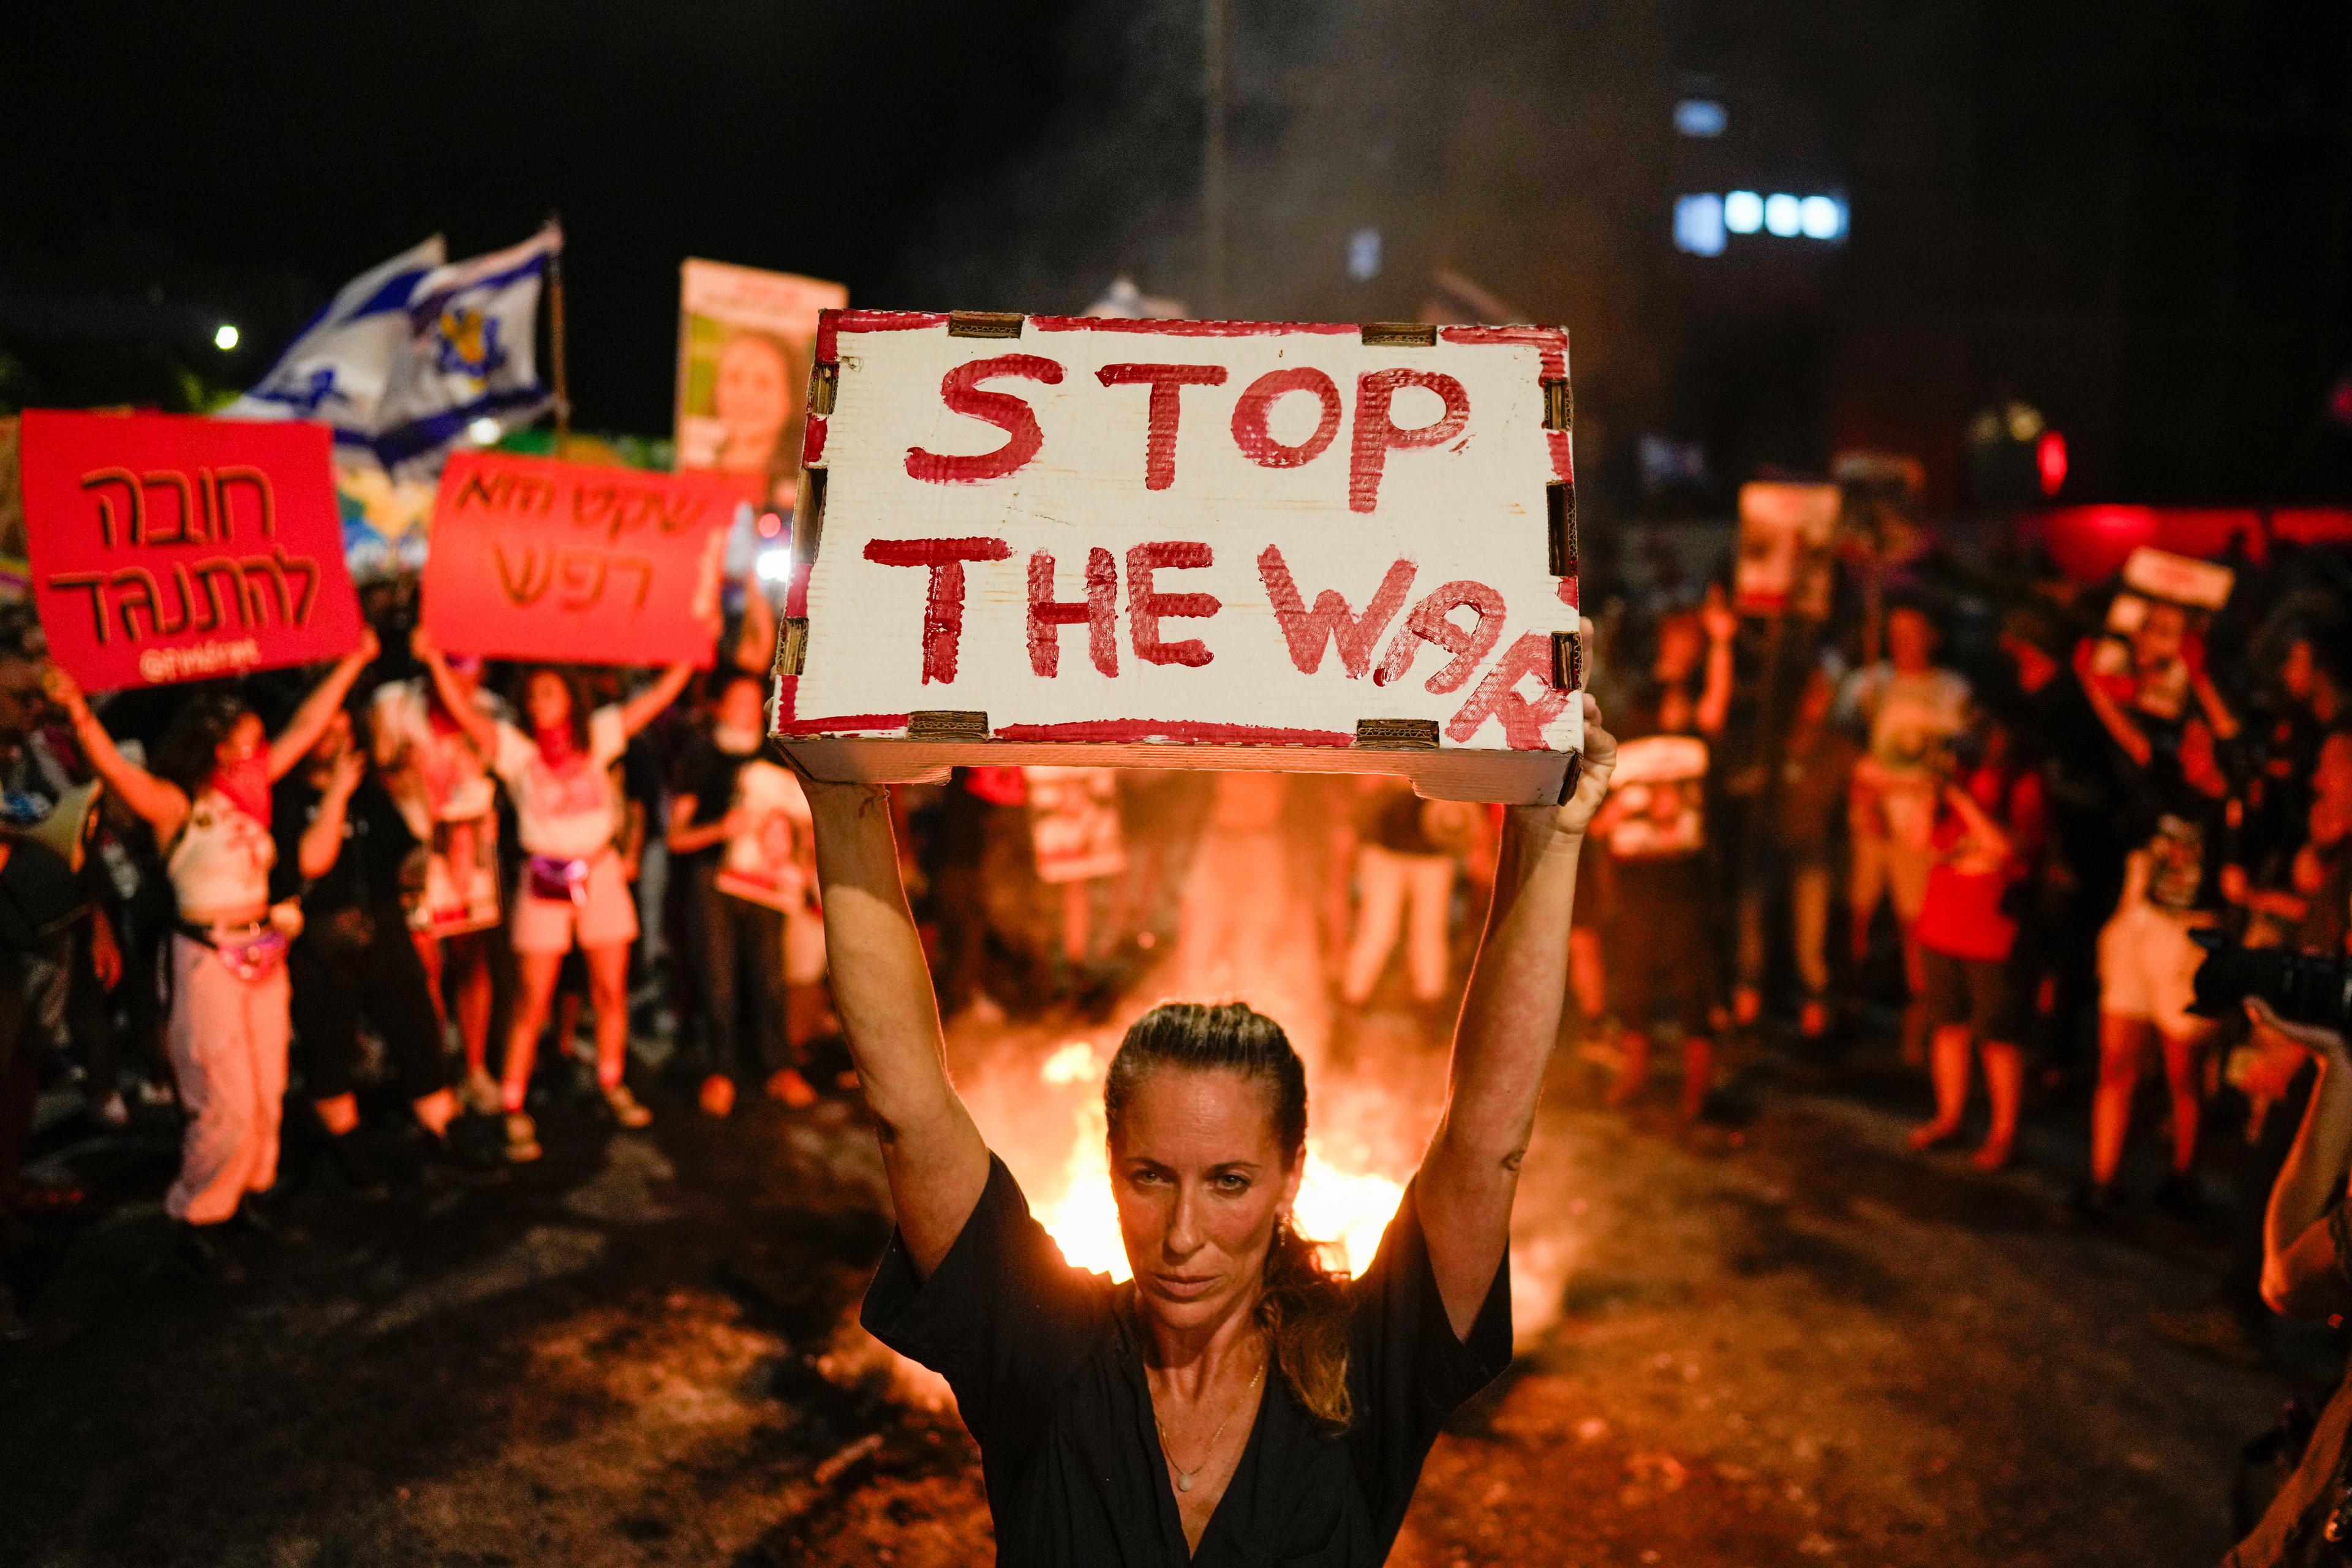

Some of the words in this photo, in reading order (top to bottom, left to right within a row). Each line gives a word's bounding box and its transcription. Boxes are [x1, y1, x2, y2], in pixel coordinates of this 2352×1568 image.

[903, 352, 1471, 514] STOP
[81, 465, 276, 549] חובה
[48, 541, 320, 644] להתנגד
[493, 541, 652, 614] רפש
[862, 535, 1224, 686] THE
[1257, 543, 1569, 751] WAR
